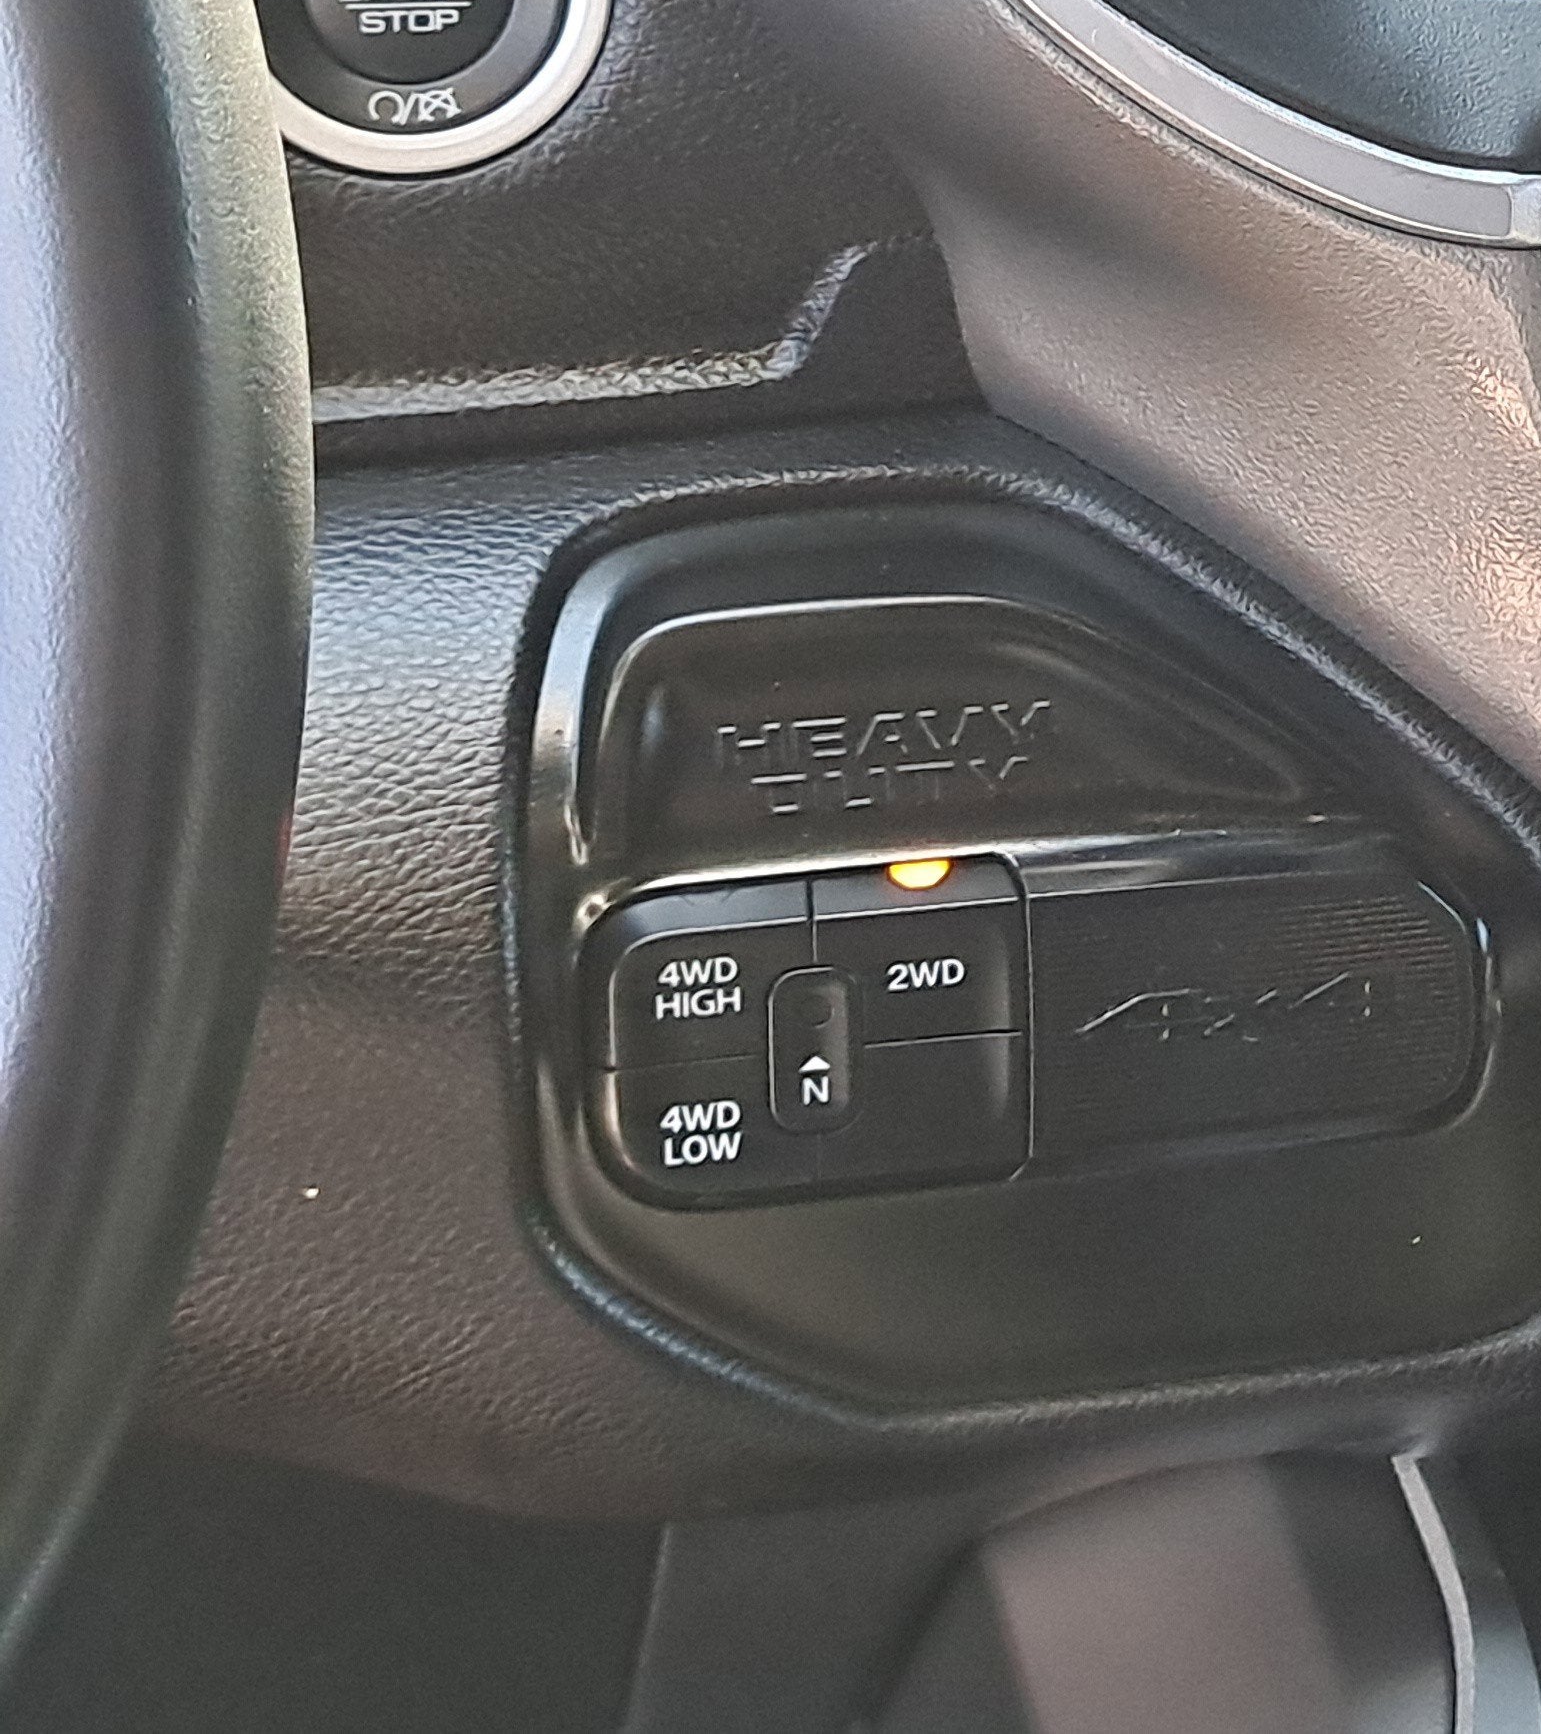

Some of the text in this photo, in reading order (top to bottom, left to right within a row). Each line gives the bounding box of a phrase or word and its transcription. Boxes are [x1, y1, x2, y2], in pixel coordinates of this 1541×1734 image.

[359, 8, 461, 35] STOP
[716, 699, 1053, 763] HEAVY
[656, 955, 739, 987] 4WD
[886, 957, 966, 992] 2WD
[654, 987, 743, 1020] HIGH
[802, 1075, 830, 1105] N
[659, 1100, 742, 1131] 4WD
[662, 1131, 743, 1166] LOW
